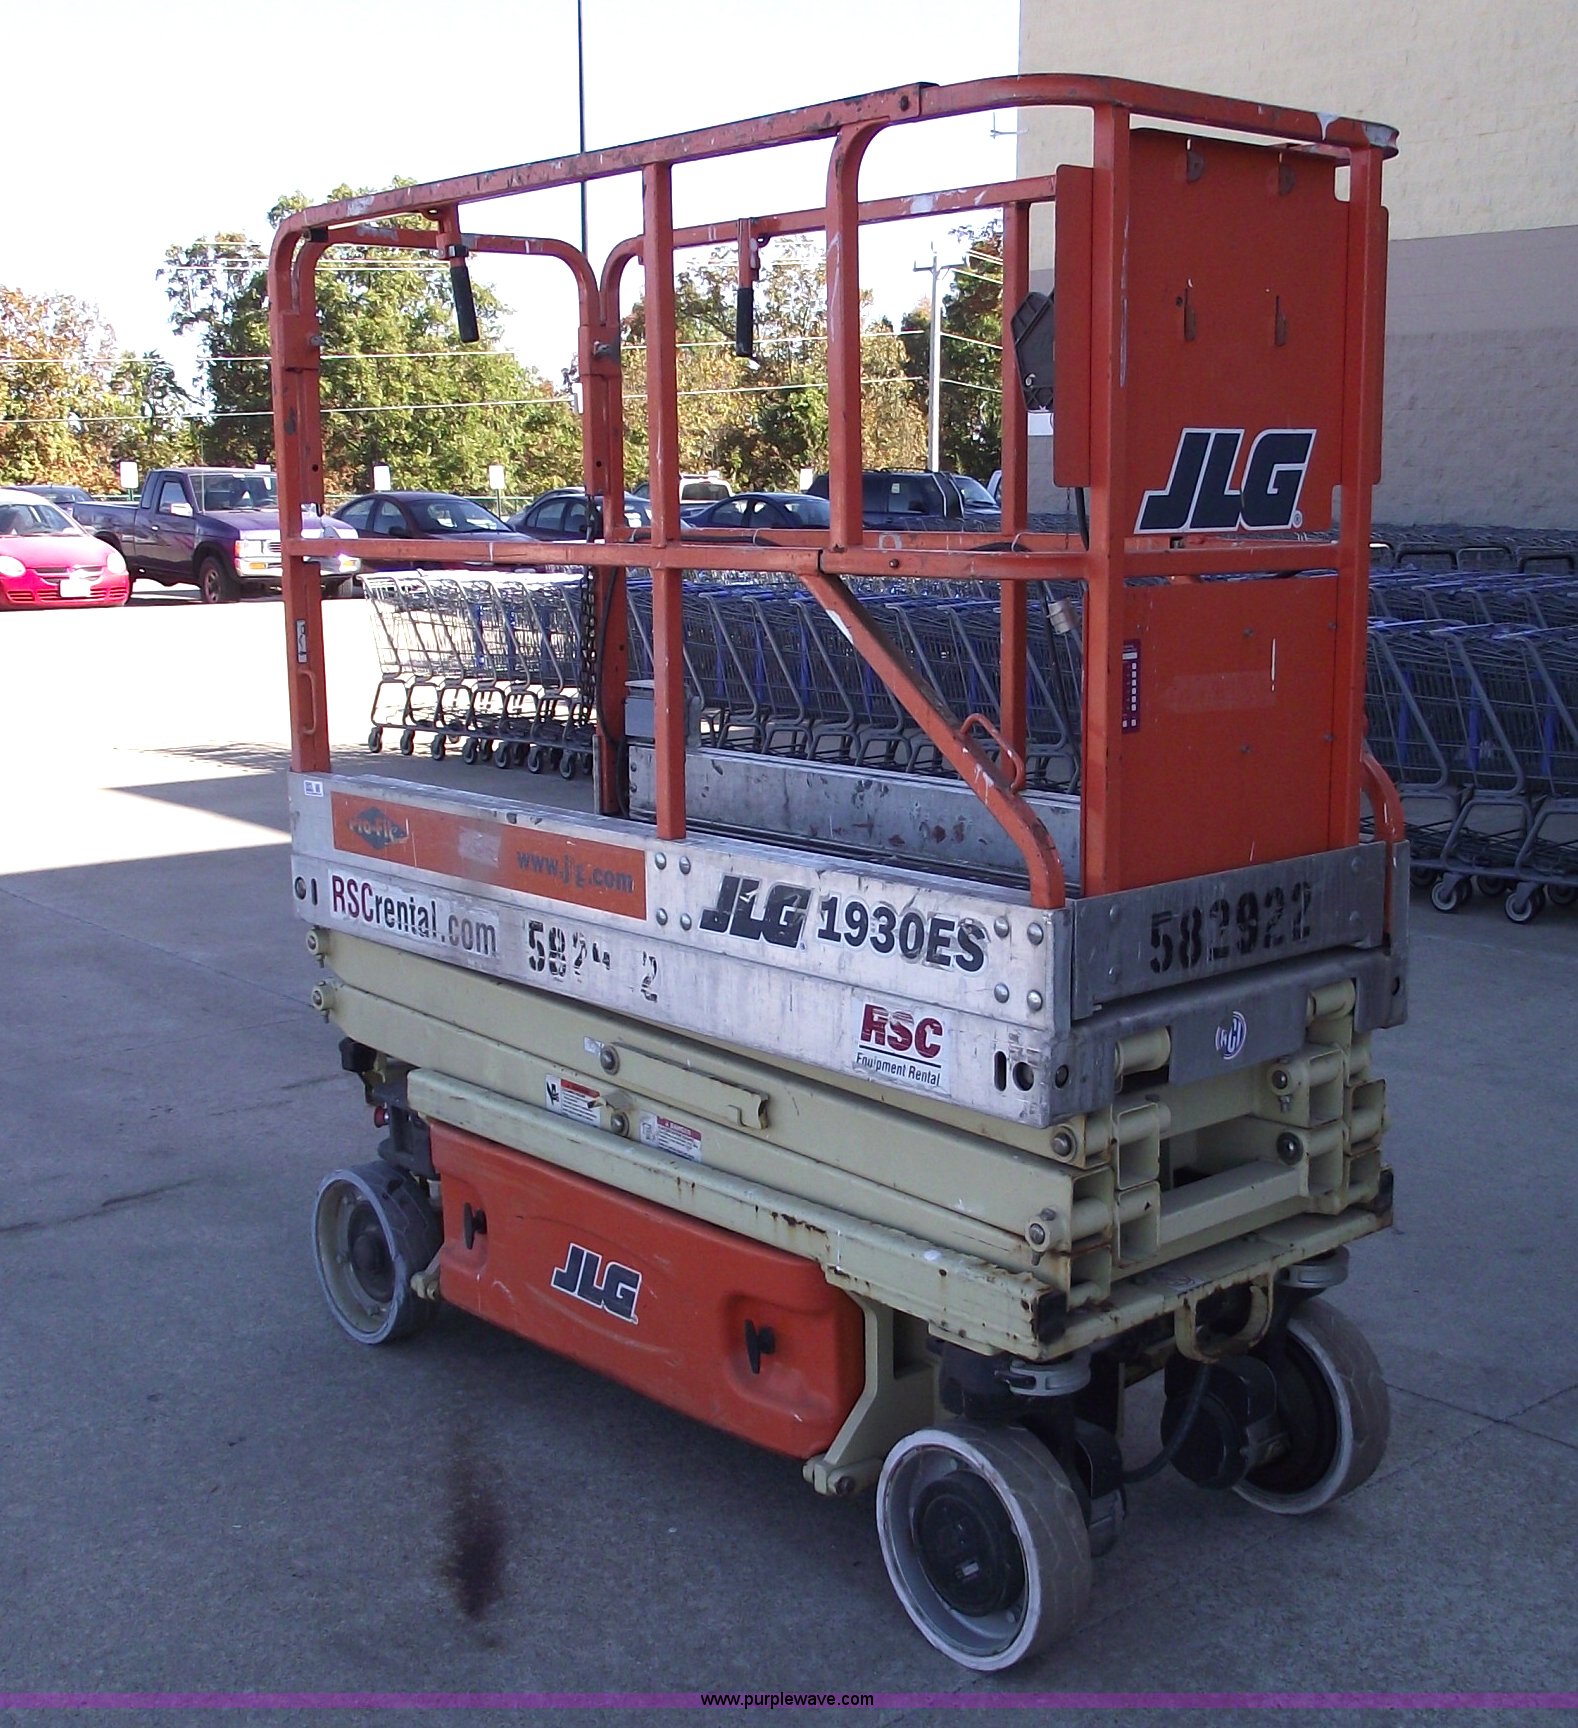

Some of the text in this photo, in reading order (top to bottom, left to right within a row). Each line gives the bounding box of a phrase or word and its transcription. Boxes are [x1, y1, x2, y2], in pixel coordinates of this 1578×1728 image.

[1135, 428, 1317, 533] JLG
[331, 874, 498, 956] RSCrental.com
[699, 873, 987, 973] JLG 1930ES
[859, 1003, 943, 1059] RSC
[907, 1065, 941, 1087] Rental
[550, 1242, 642, 1324] JLG
